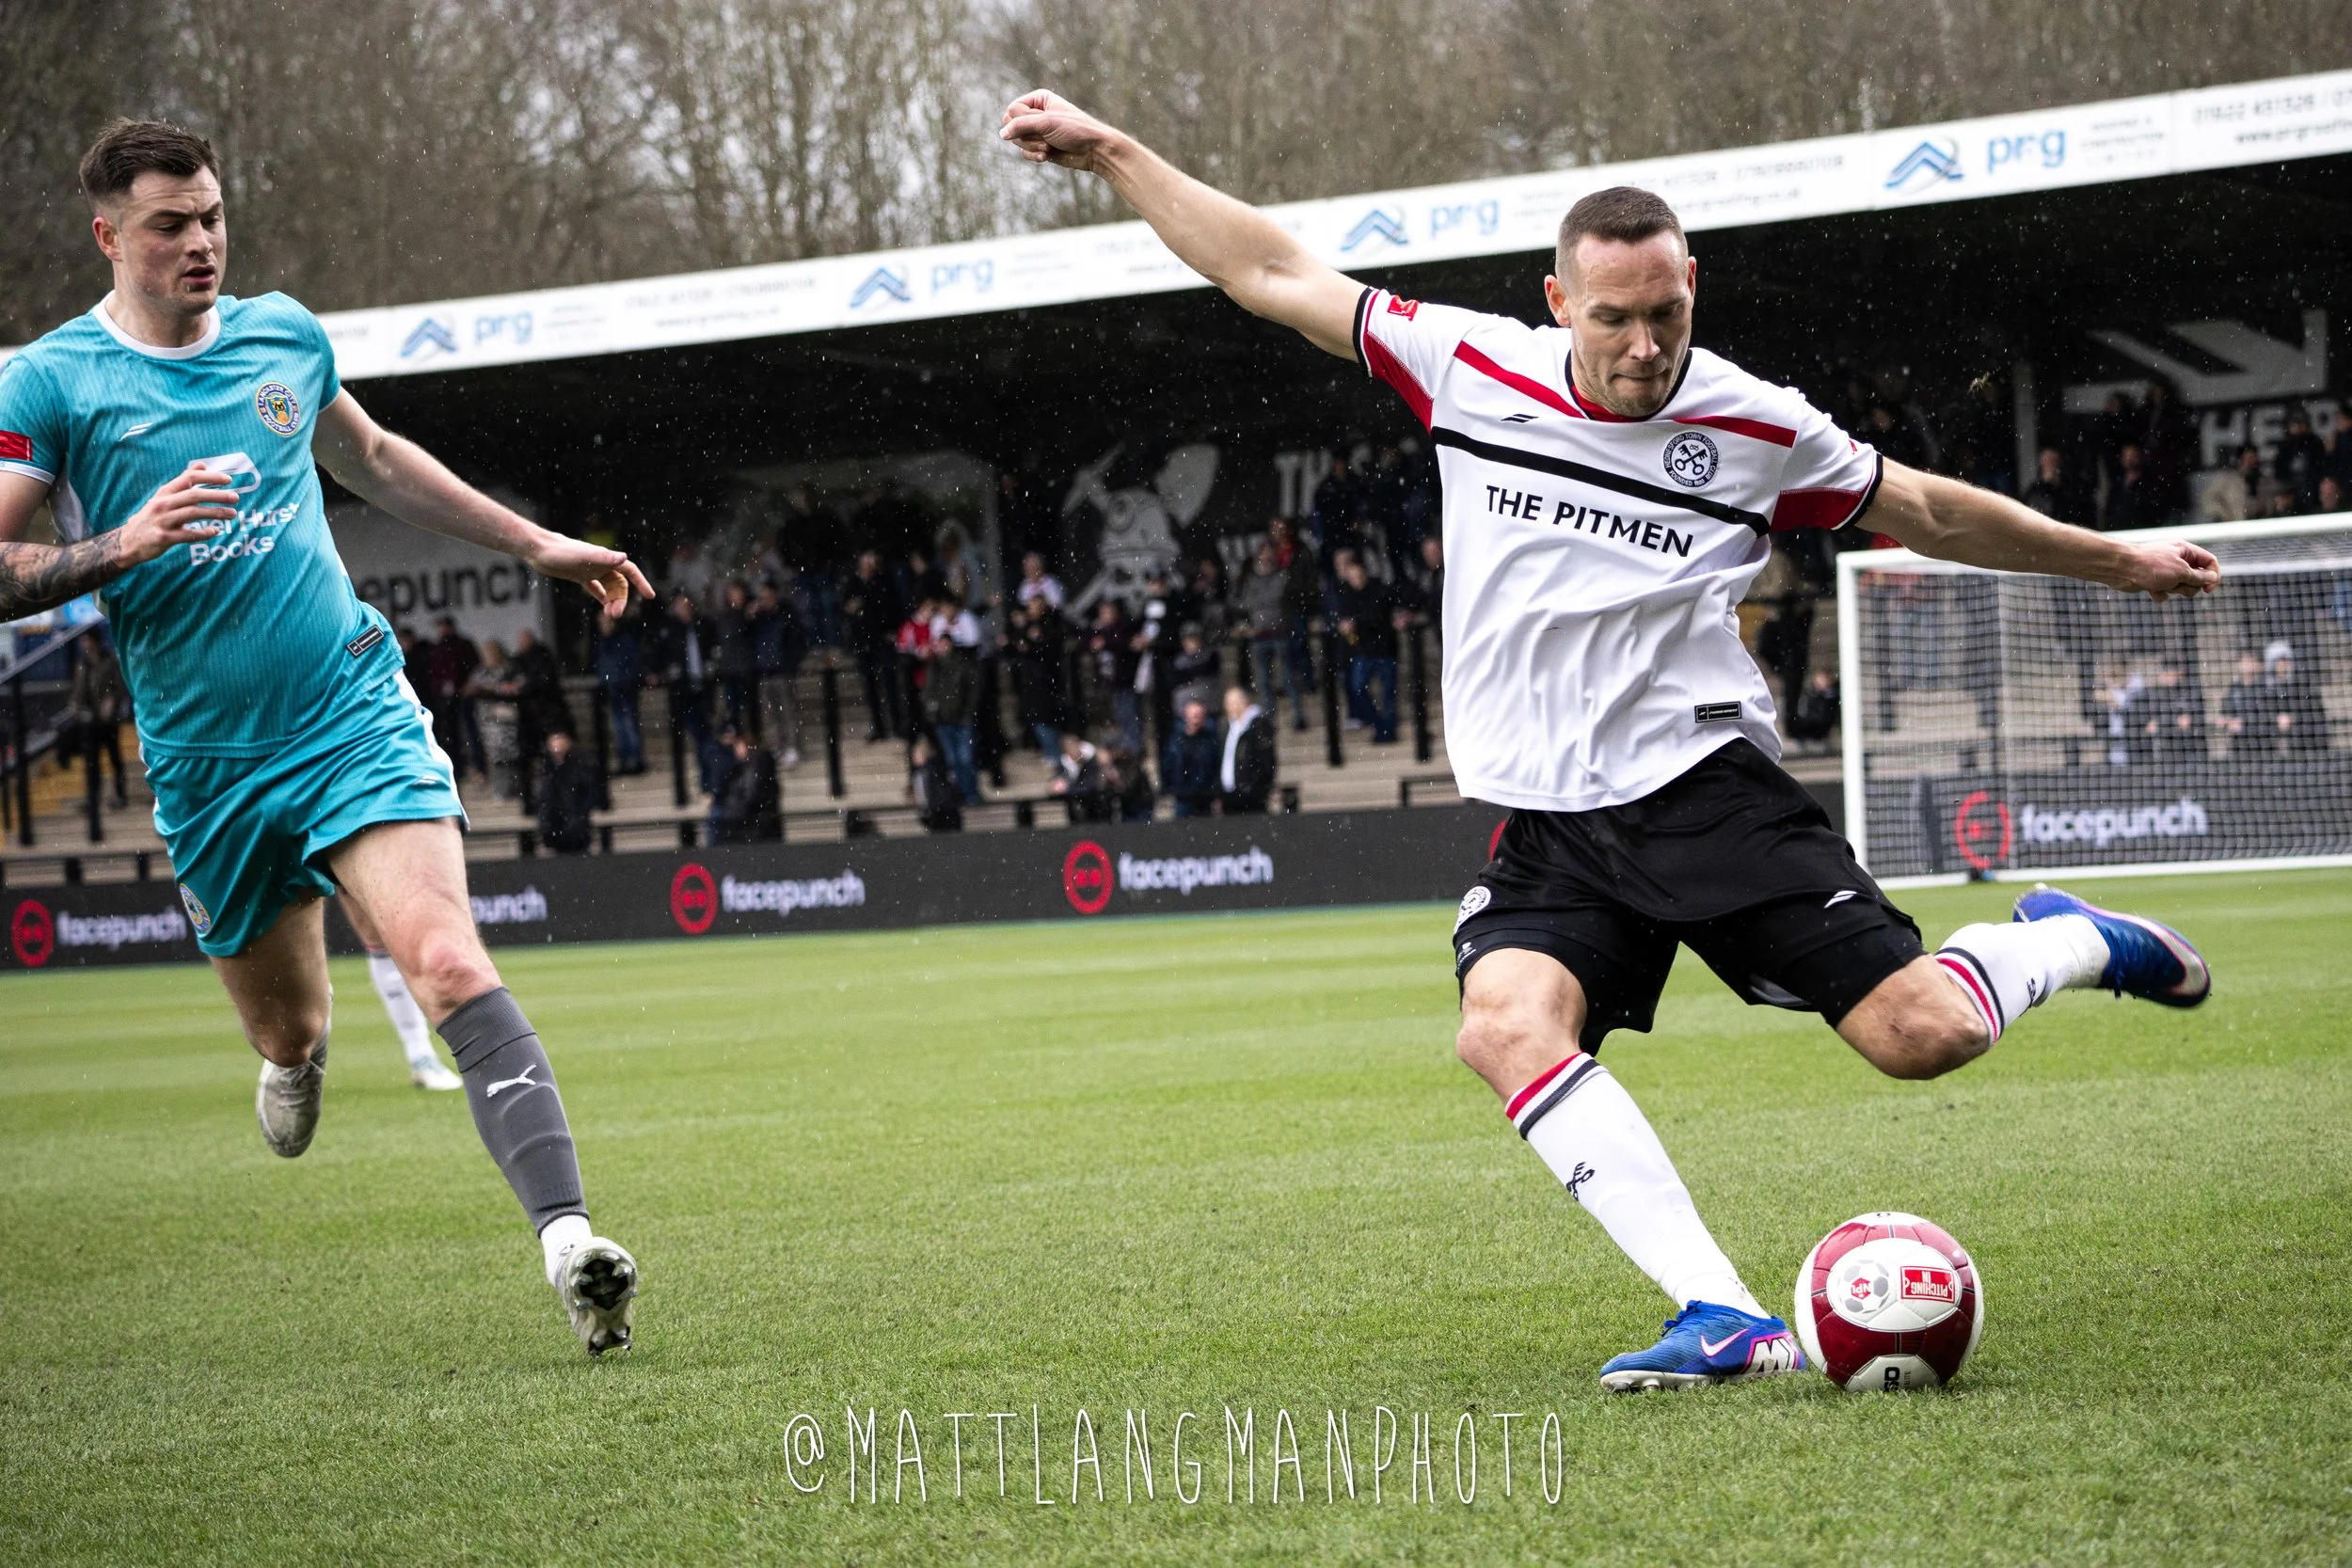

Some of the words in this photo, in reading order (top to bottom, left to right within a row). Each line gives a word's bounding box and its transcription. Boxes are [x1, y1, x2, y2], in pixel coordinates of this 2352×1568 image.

[1987, 128, 2067, 173] prg
[1430, 198, 1500, 236] prg
[931, 259, 994, 293] prg
[474, 310, 533, 345] prg
[1486, 484, 1543, 521] THE
[1552, 500, 1693, 558] PITMEN
[190, 533, 275, 566] Books
[2022, 796, 2208, 847] facepunch
[1119, 847, 1274, 895] facepunch
[469, 885, 548, 925] punch
[721, 870, 866, 917] facepunch
[57, 906, 187, 951] facepunch
[1851, 1282, 1871, 1293] NPL
[1911, 1282, 1948, 1297] PITCHING
[1921, 1271, 1931, 1283] IN
